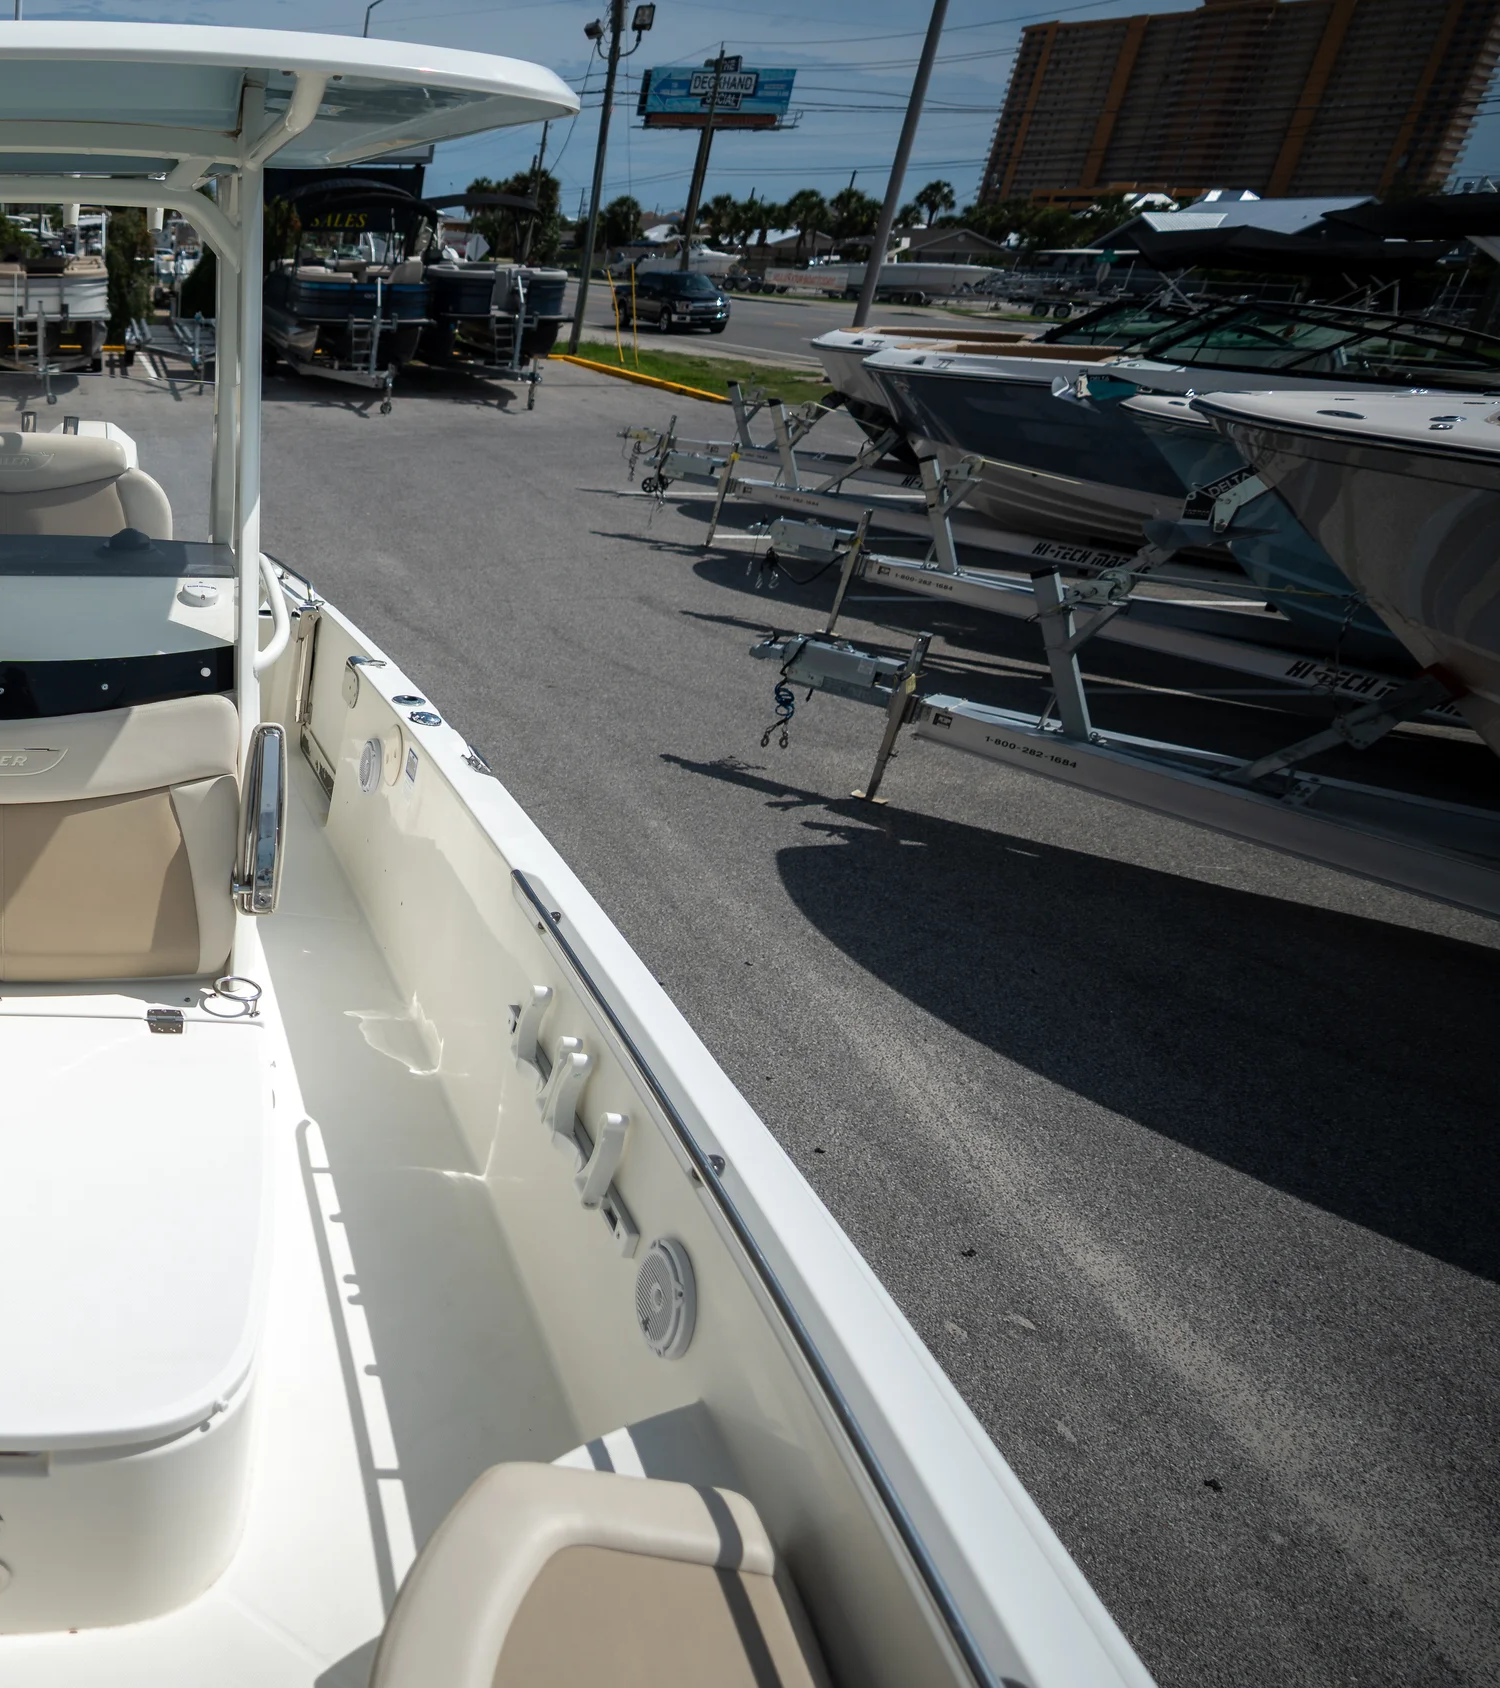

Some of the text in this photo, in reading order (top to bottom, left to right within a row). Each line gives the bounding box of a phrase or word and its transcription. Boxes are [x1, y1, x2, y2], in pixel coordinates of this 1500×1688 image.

[706, 92, 736, 105] SCIAL
[309, 211, 369, 229] SALES
[1208, 471, 1252, 497] DELTA
[1032, 542, 1092, 563] HI-TECH
[894, 572, 953, 592] 1-800-282-1684
[984, 735, 1078, 770] 1-800-282-1684
